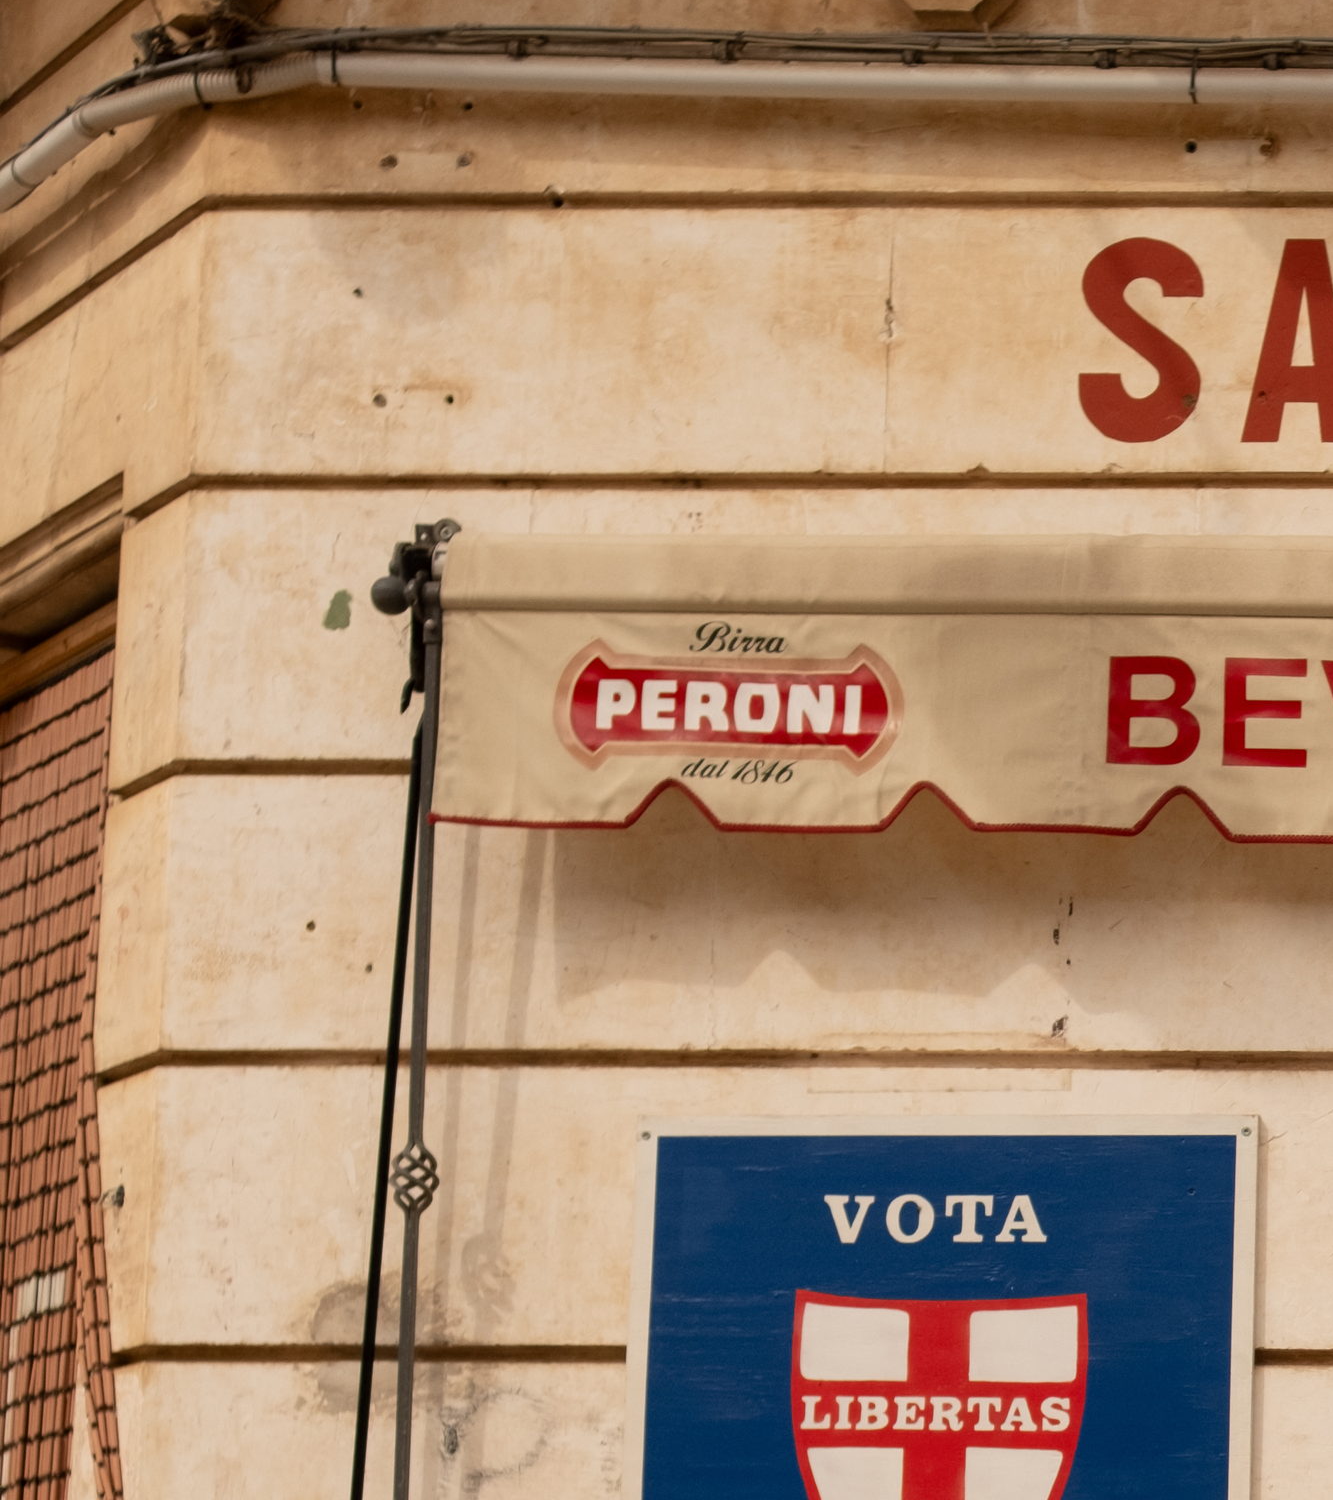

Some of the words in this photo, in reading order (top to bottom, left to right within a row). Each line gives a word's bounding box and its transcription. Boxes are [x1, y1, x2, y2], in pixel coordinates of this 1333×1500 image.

[690, 620, 788, 655] Birra
[595, 679, 863, 735] PERONI
[681, 760, 728, 781] dal
[731, 761, 796, 785] 1846
[823, 1193, 1048, 1245] VOTA
[799, 1395, 1071, 1433] LIBERTAS
